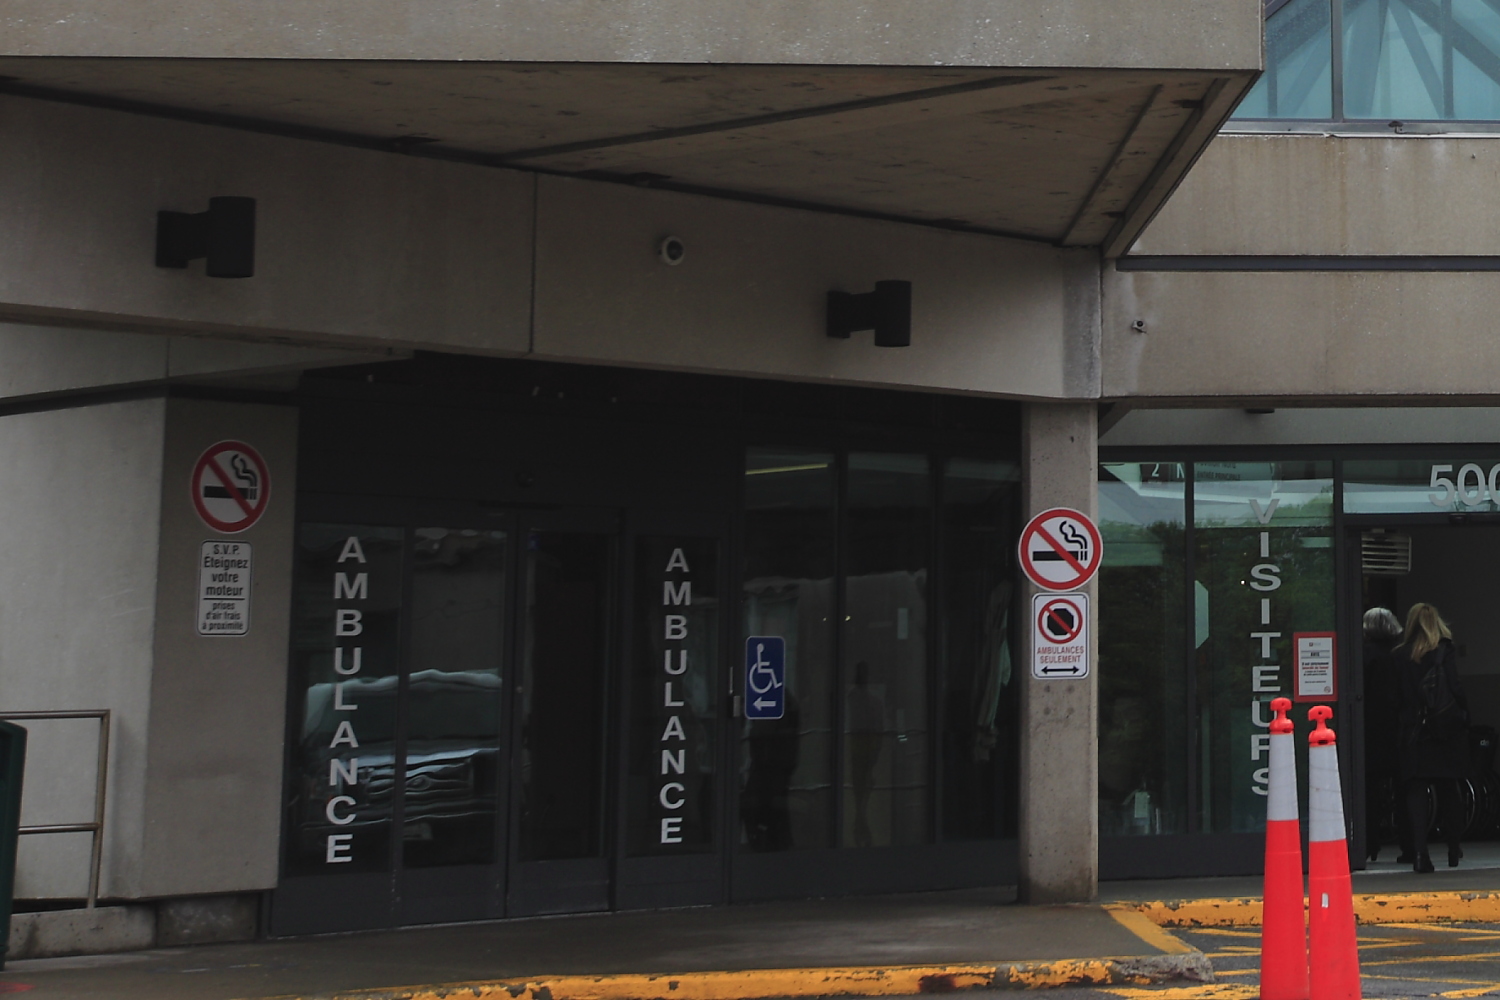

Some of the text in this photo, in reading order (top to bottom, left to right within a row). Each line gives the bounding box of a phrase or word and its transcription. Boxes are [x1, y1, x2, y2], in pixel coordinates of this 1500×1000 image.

[204, 553, 249, 570] Éteignez
[211, 572, 239, 583] votre
[206, 585, 243, 596] moteur
[1037, 645, 1085, 655] AMBULANCES
[1040, 655, 1081, 664] SEULEMENT
[325, 536, 369, 865] AMBULANCE
[658, 547, 692, 845] AMBULANCE
